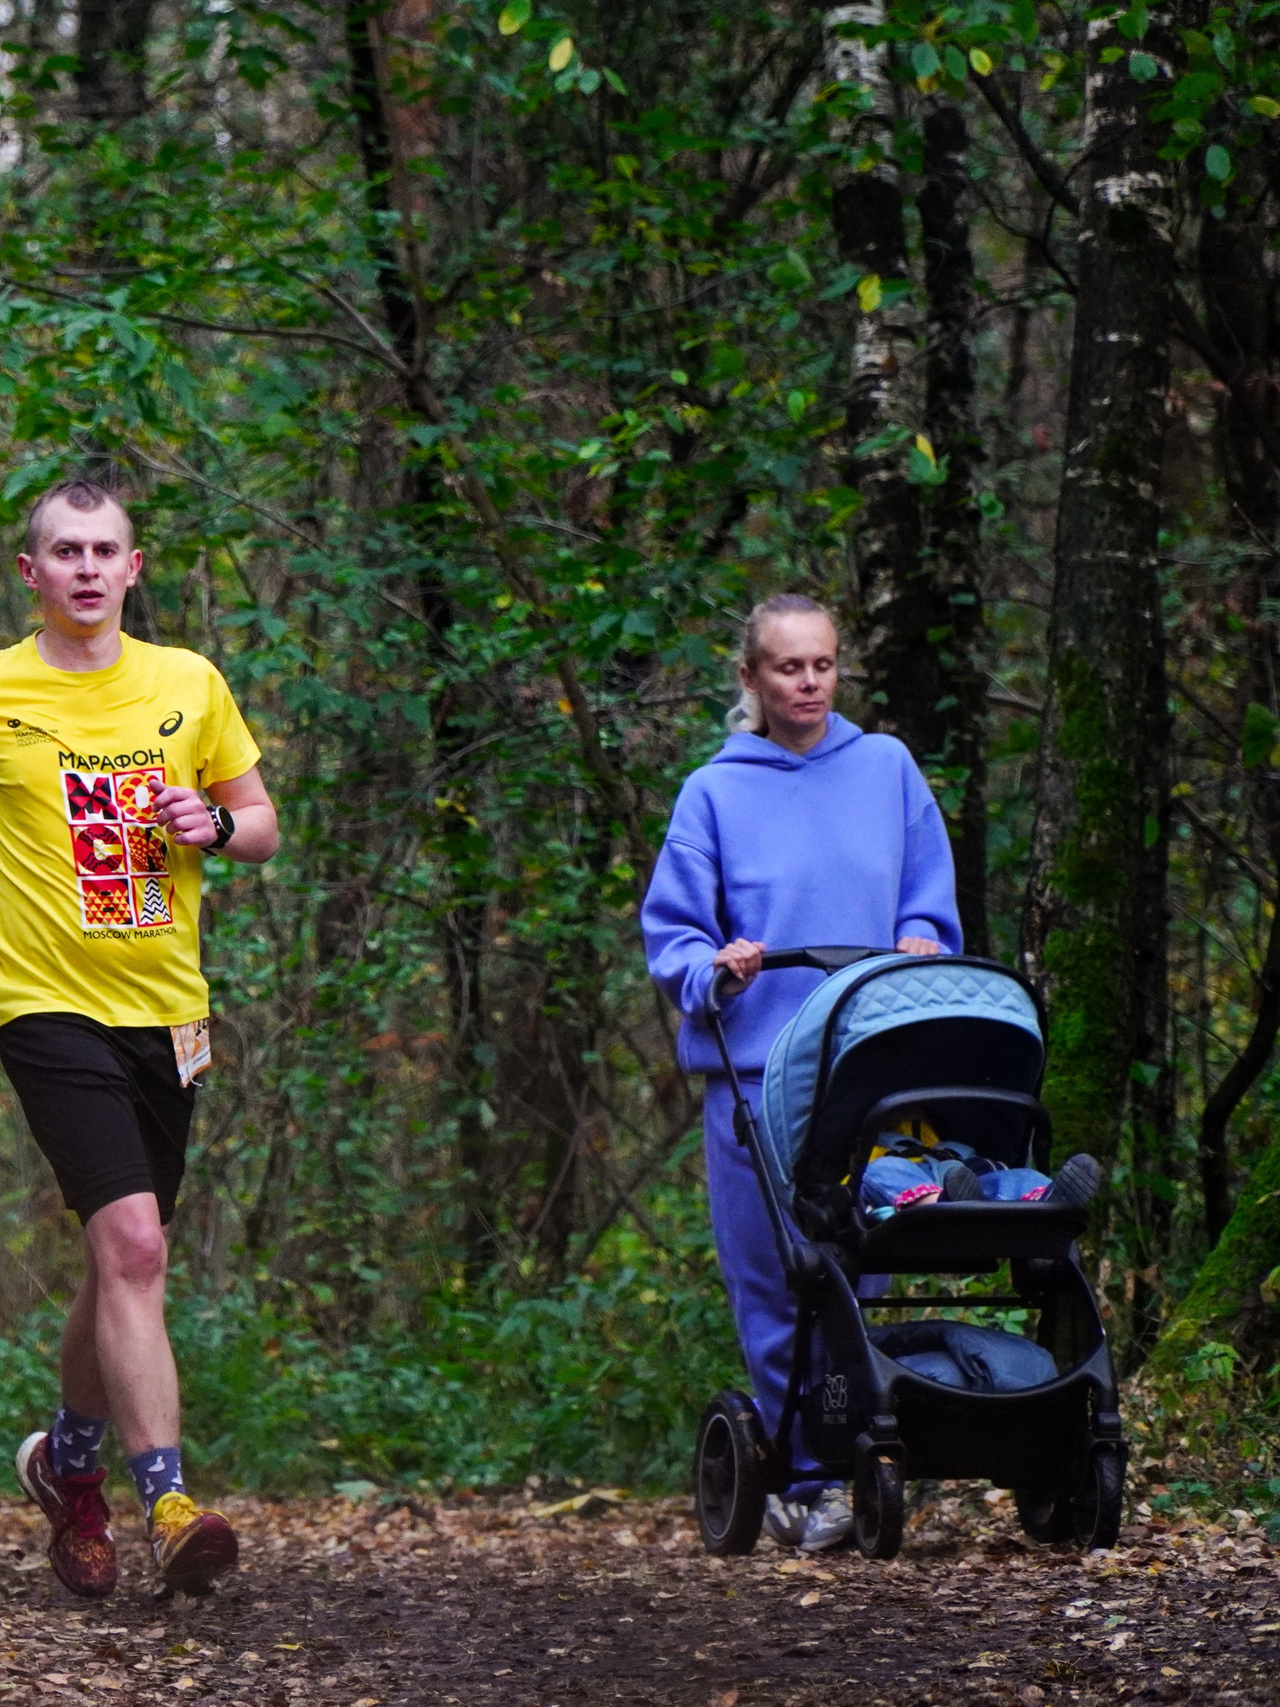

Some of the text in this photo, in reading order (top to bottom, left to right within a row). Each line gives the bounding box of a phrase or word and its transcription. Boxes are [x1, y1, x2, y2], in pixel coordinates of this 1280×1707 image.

[58, 748, 165, 771] МАРАФОН
[83, 926, 177, 939] MOSCOW MARATHON
